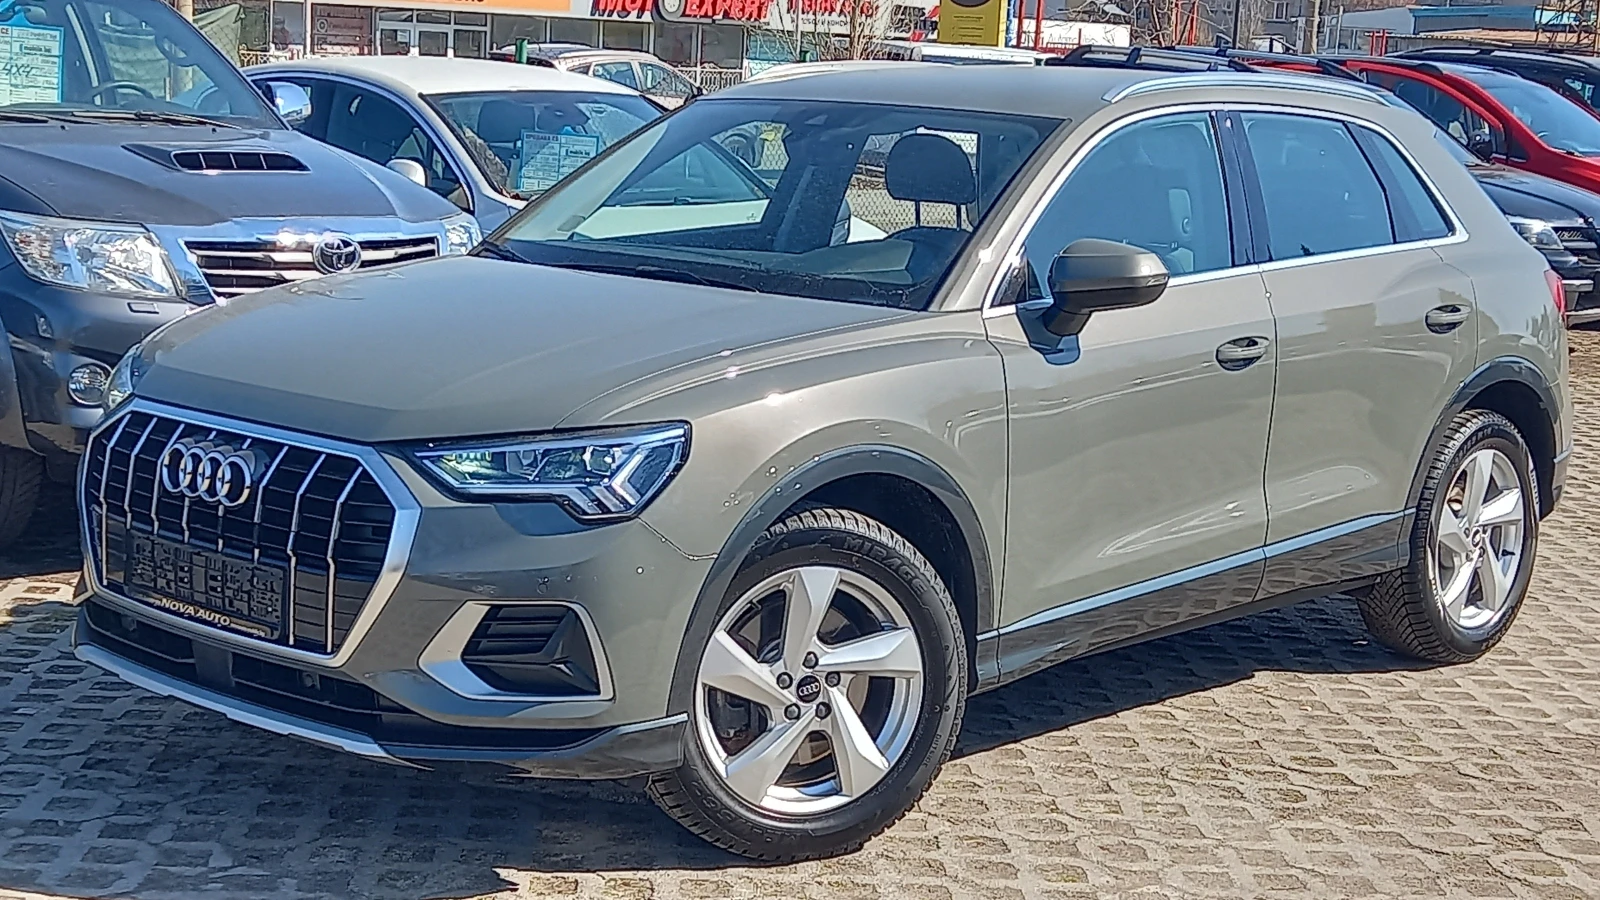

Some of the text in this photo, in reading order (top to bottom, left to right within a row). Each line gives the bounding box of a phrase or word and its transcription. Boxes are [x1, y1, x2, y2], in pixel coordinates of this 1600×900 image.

[843, 536, 928, 595] MIRAGE
[160, 597, 195, 616] NOVA
[196, 609, 231, 626] AUTO
